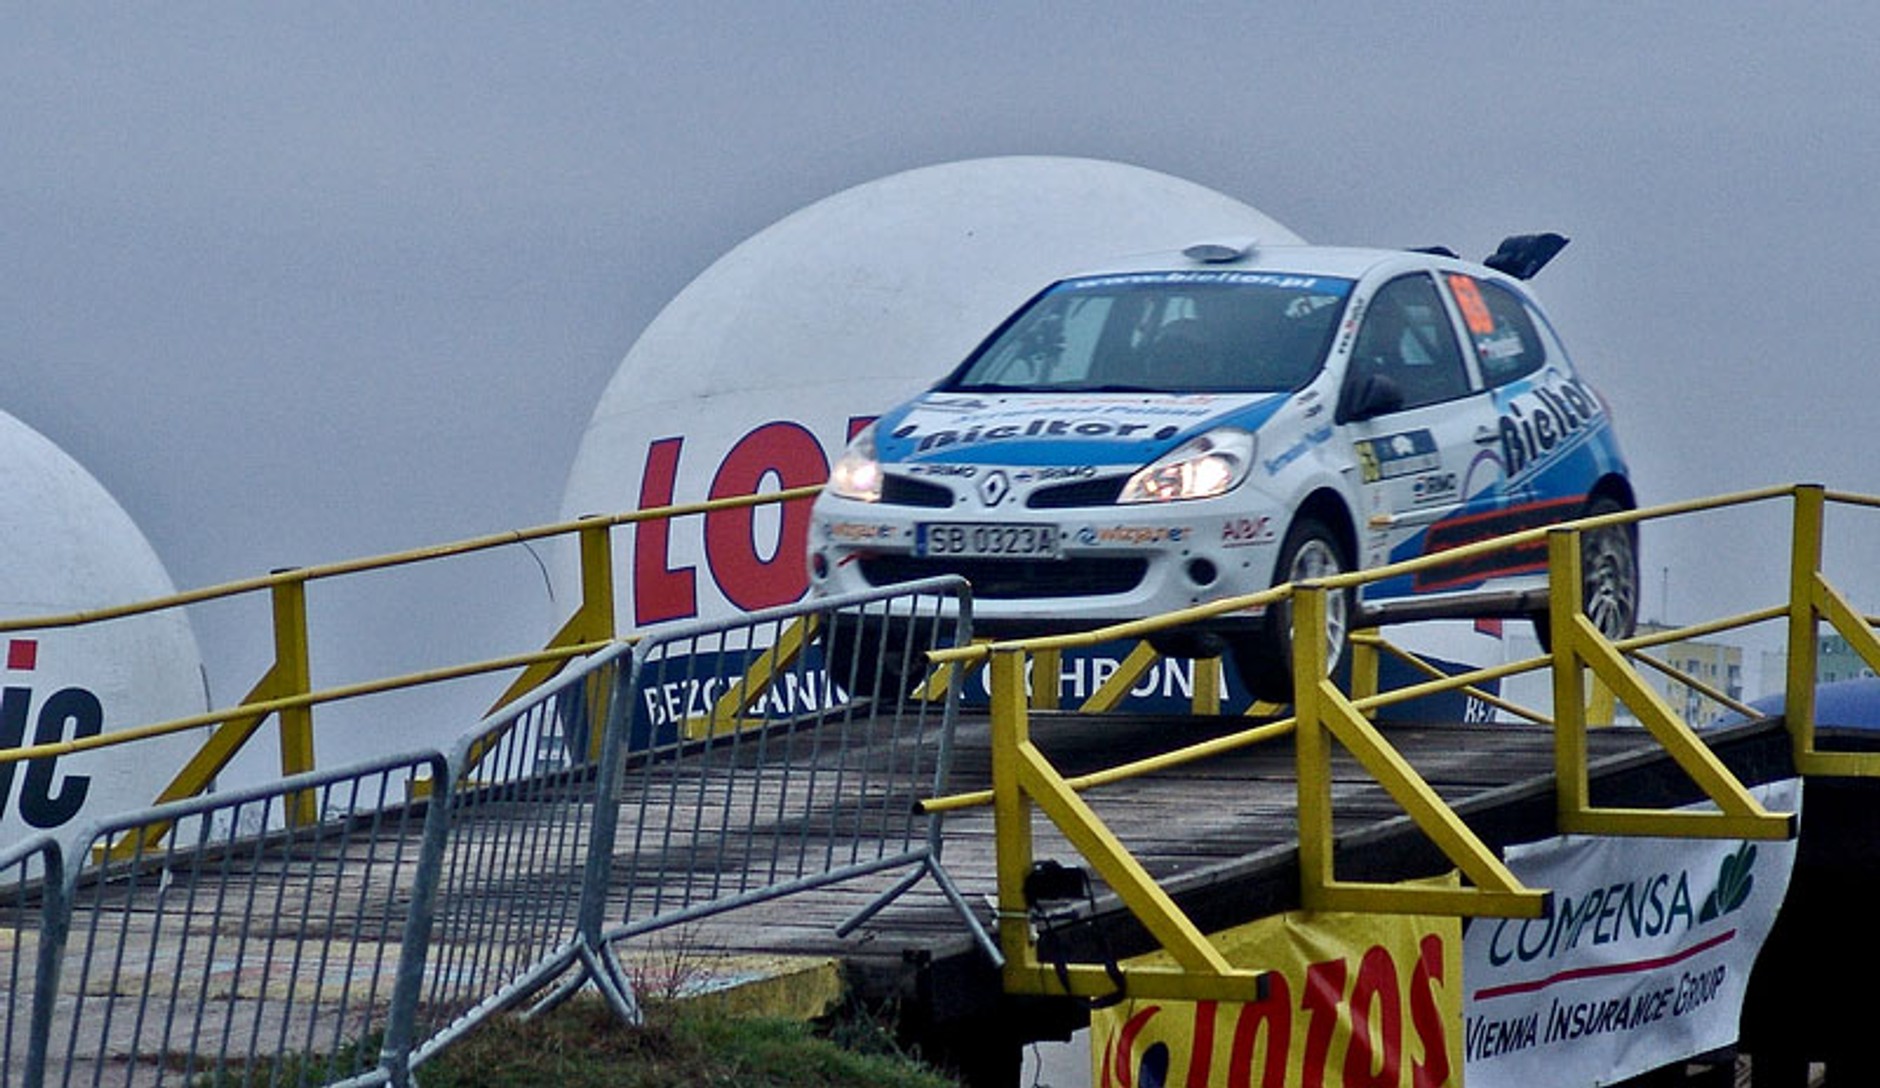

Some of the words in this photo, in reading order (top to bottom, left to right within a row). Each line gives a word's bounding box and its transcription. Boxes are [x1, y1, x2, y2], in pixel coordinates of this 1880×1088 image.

[918, 419, 1150, 451] Bieltor
[931, 526, 967, 554] SB
[974, 527, 1053, 556] 0323A
[1489, 869, 1695, 967] COMPENSA
[1466, 1013, 1538, 1063] VIENNA
[1544, 987, 1674, 1044] INSURANCE
[1672, 964, 1727, 1016] GROUP
